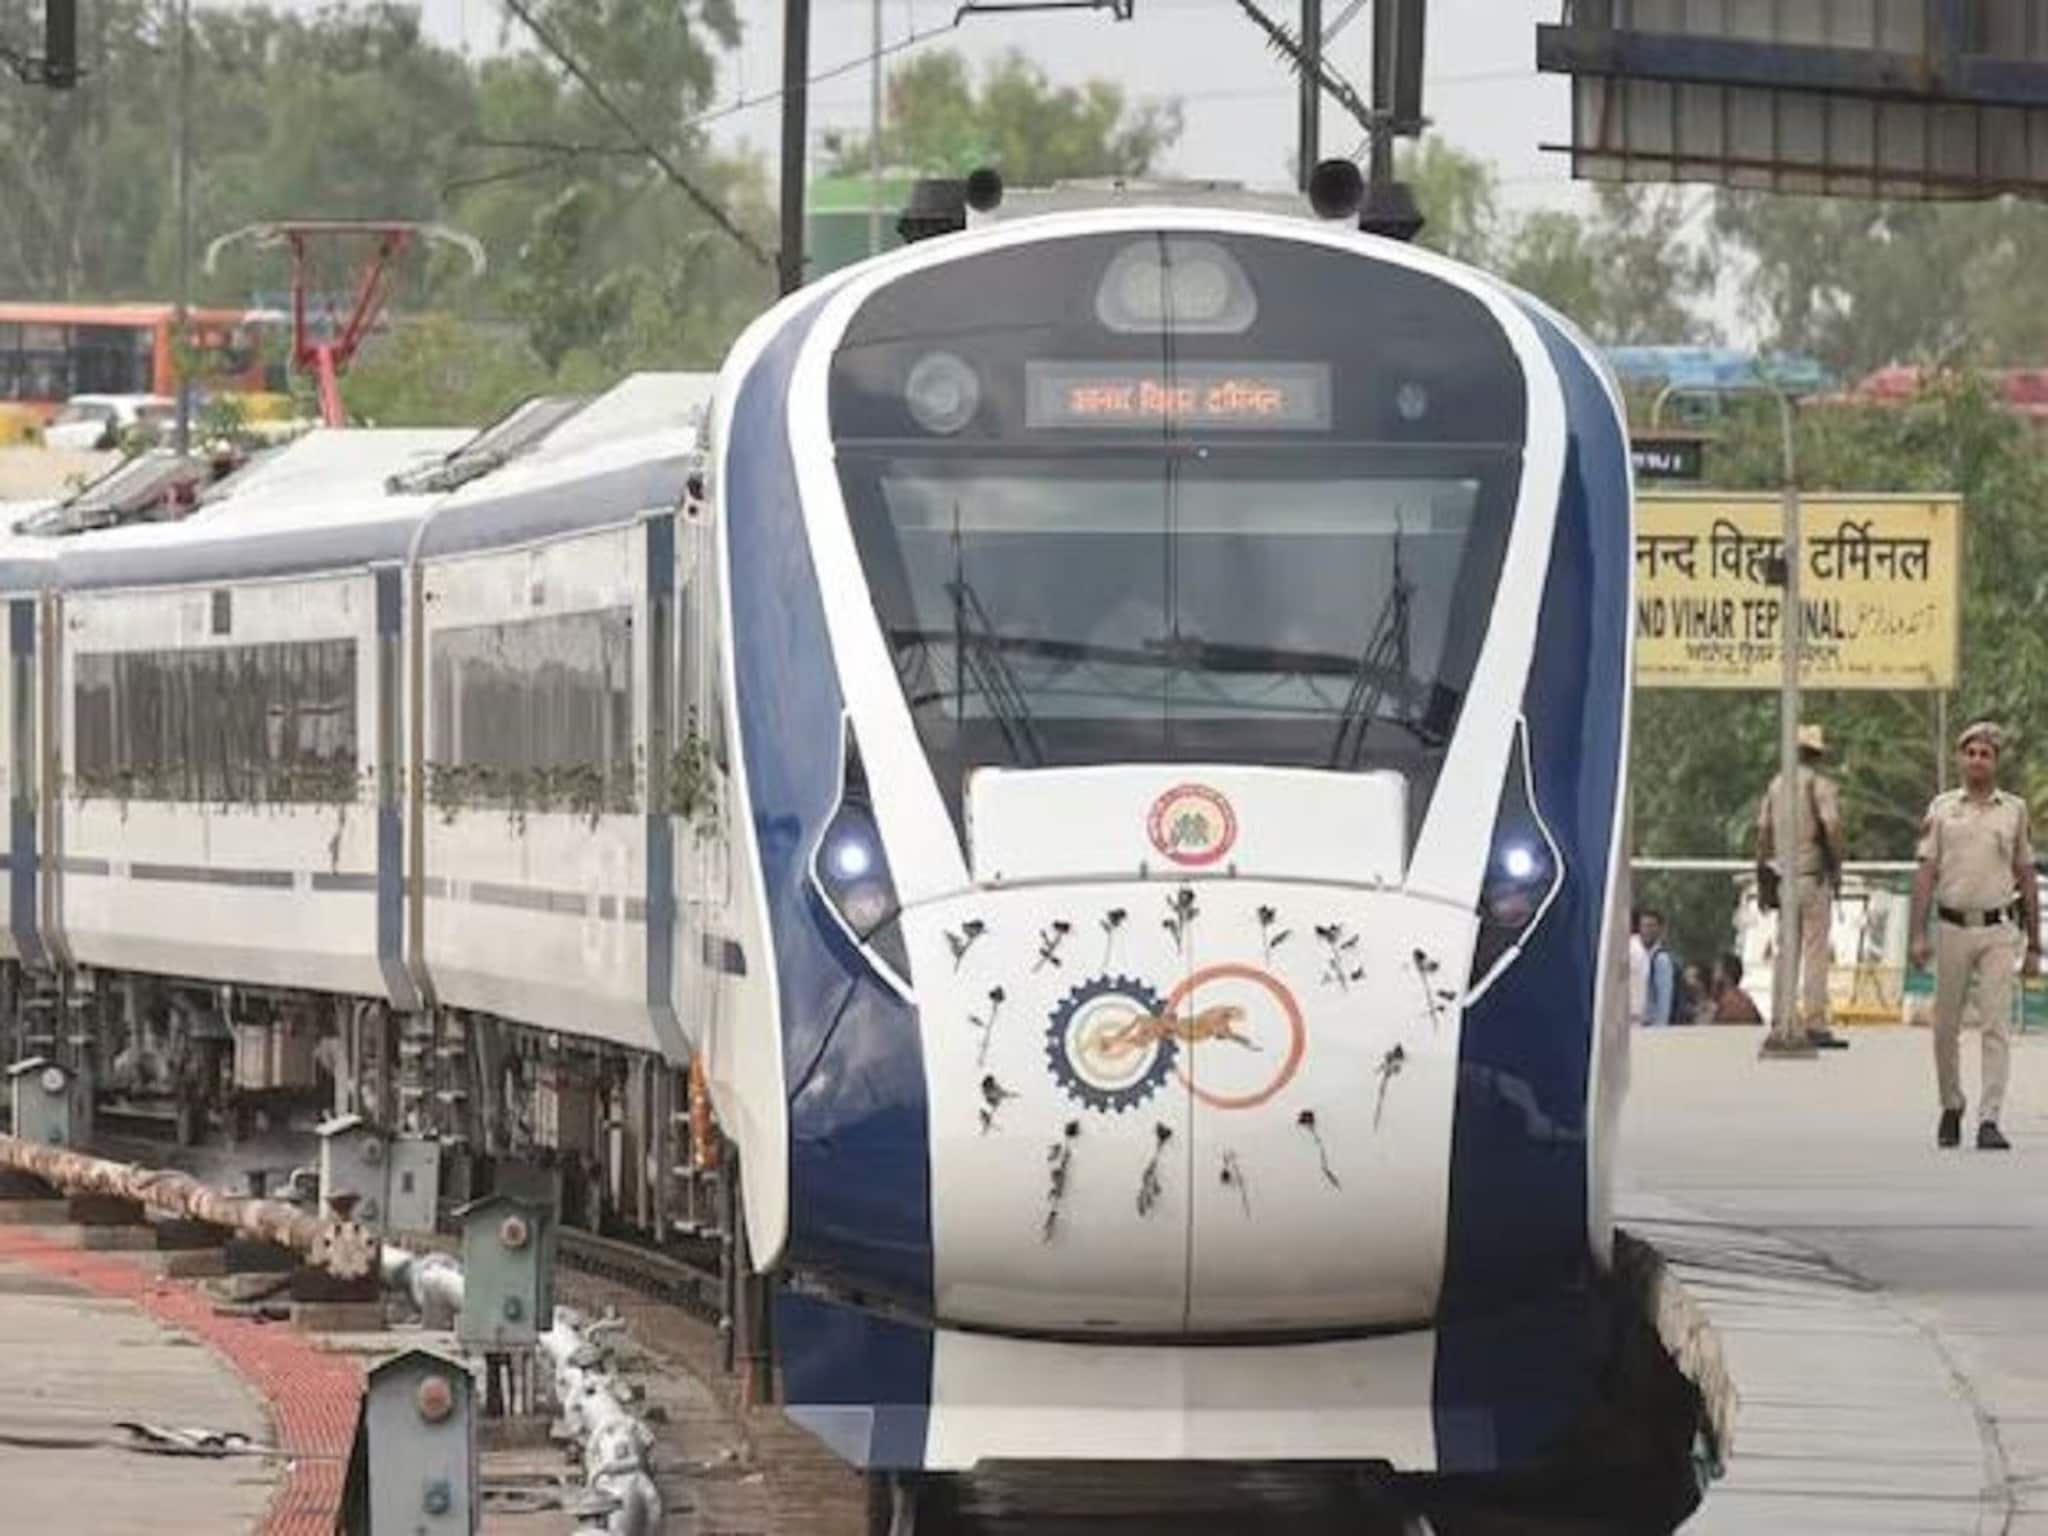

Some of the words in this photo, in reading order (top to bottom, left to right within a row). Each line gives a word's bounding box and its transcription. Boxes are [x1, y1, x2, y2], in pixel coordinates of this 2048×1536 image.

[1710, 518, 1785, 584] विहा
[1808, 519, 1931, 581] टर्मिनल
[1672, 597, 1735, 638] VIHAR
